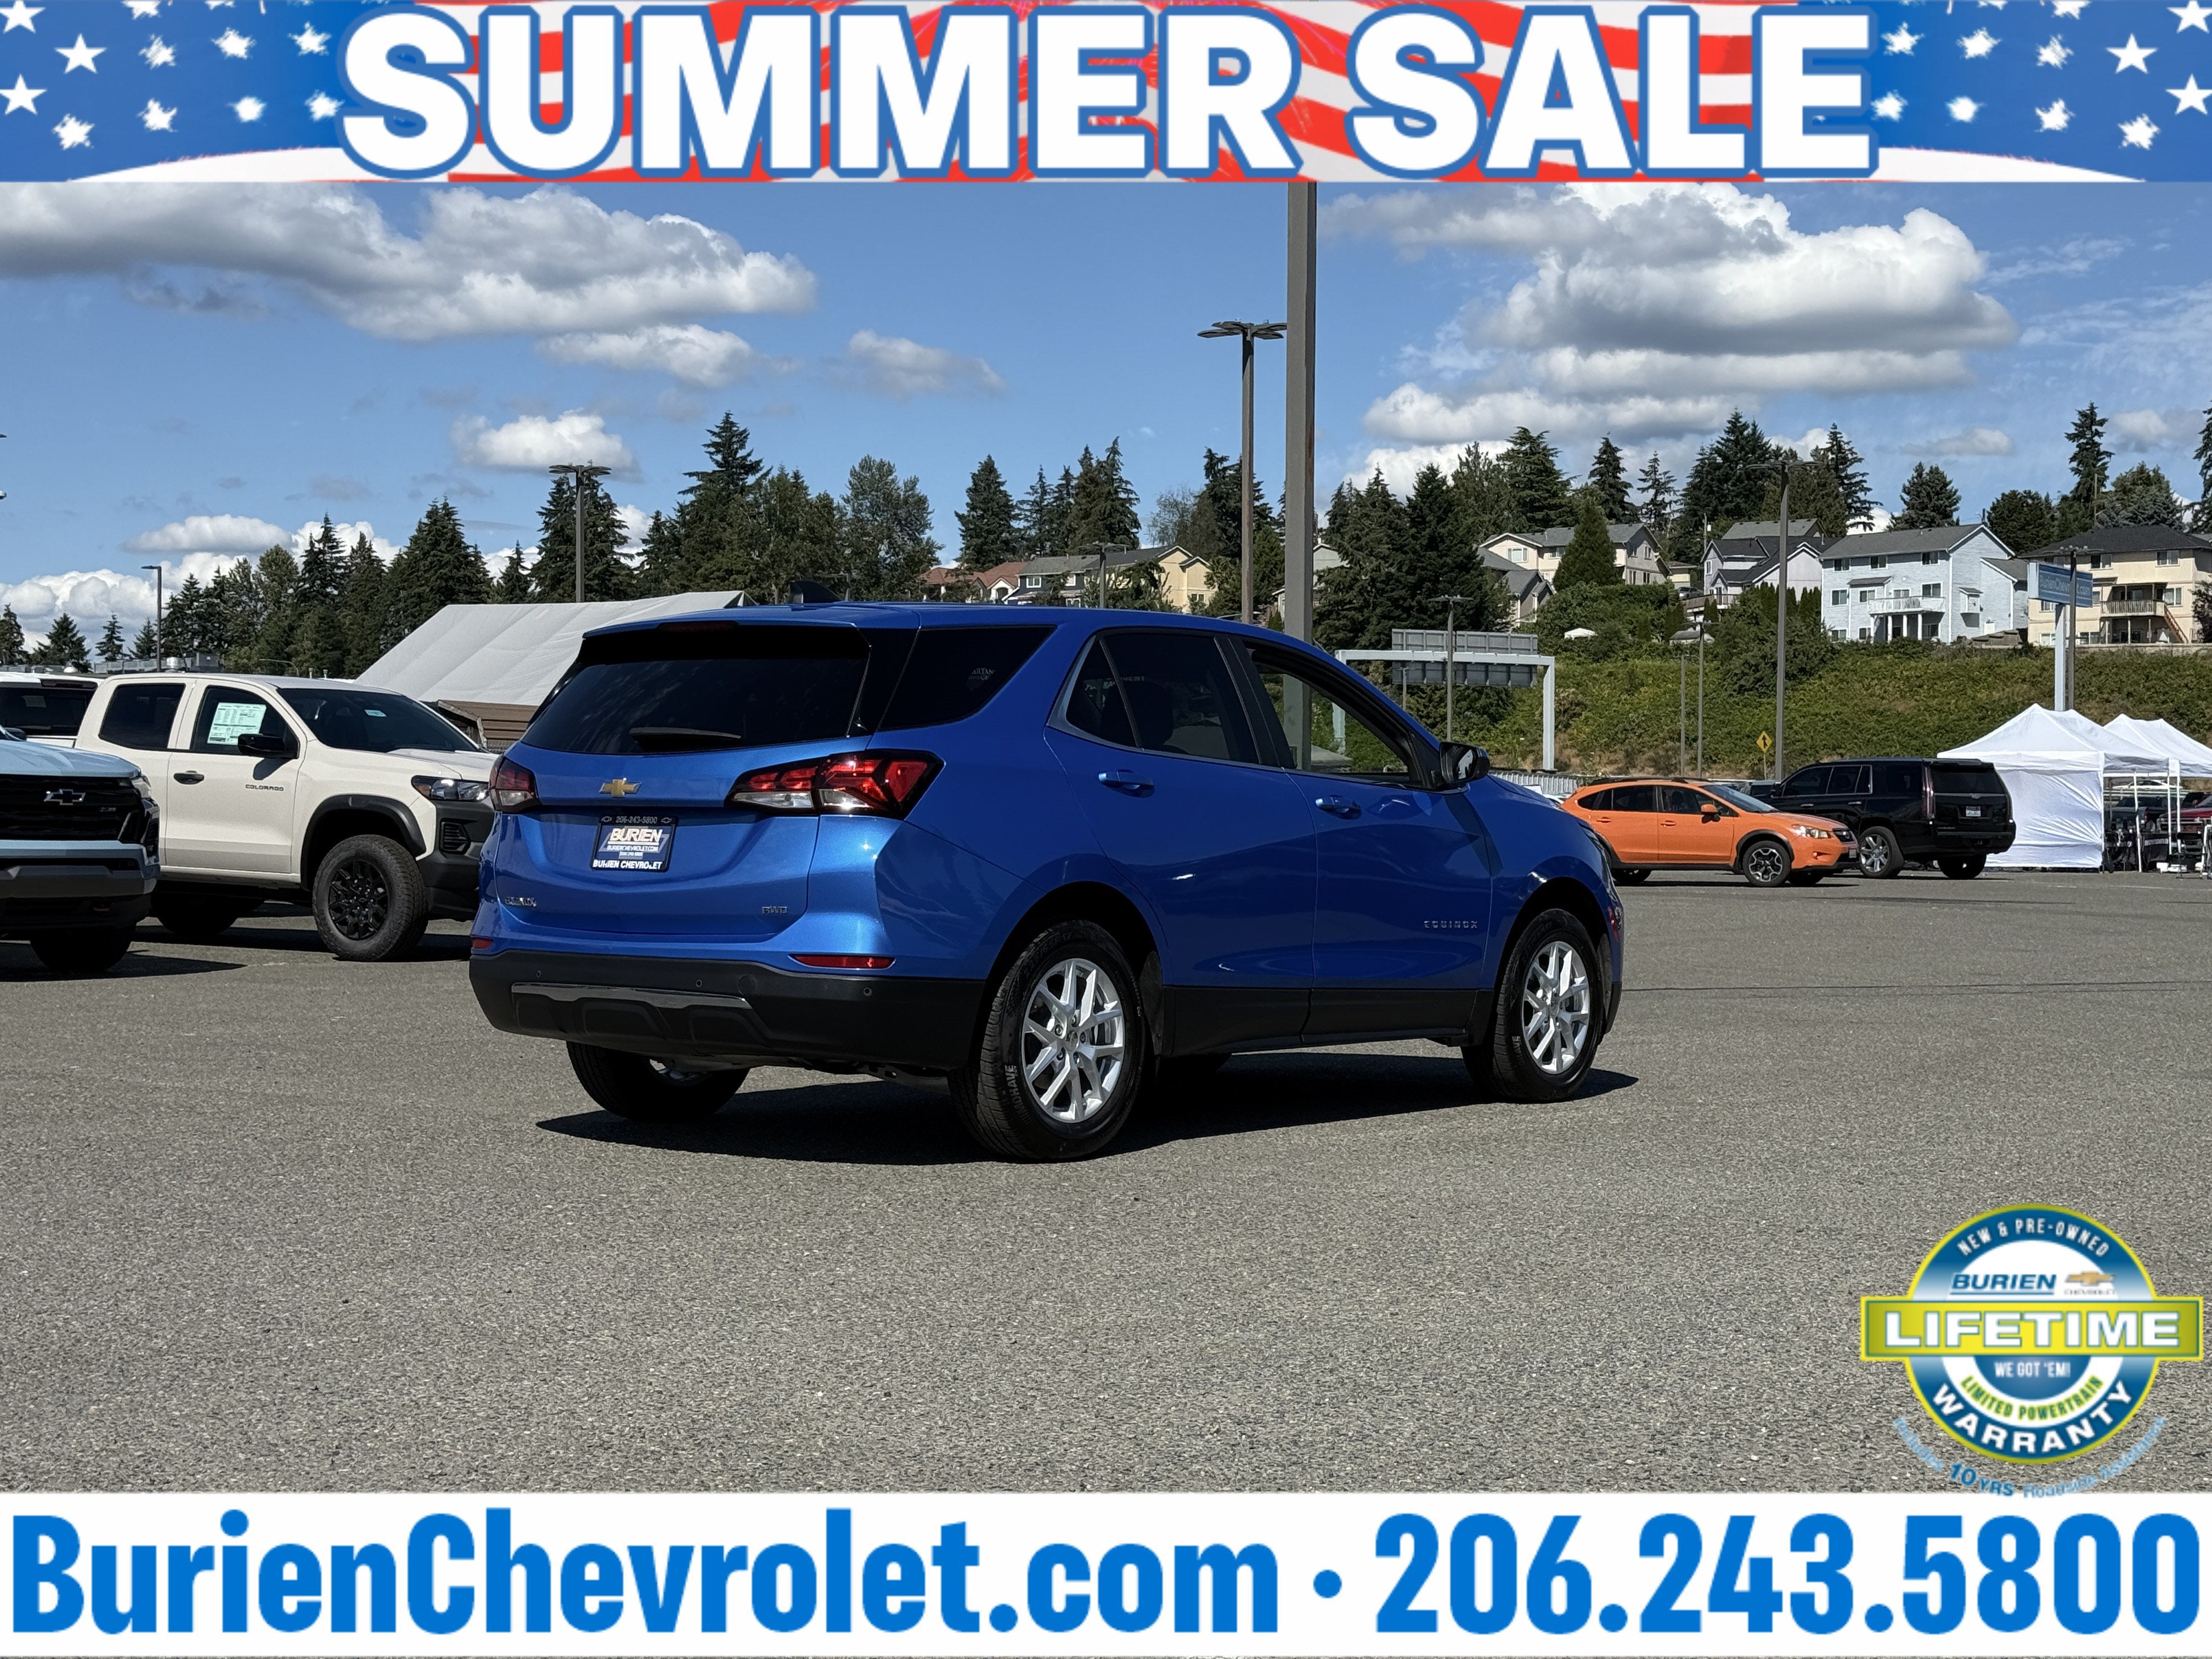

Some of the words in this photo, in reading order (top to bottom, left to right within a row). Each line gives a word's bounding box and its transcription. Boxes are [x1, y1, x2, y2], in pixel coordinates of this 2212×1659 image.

[610, 828, 663, 842] BURIEN
[592, 859, 620, 868] BURIEN
[620, 860, 663, 870] CHEVROLET
[1423, 920, 1479, 929] EQUINOX
